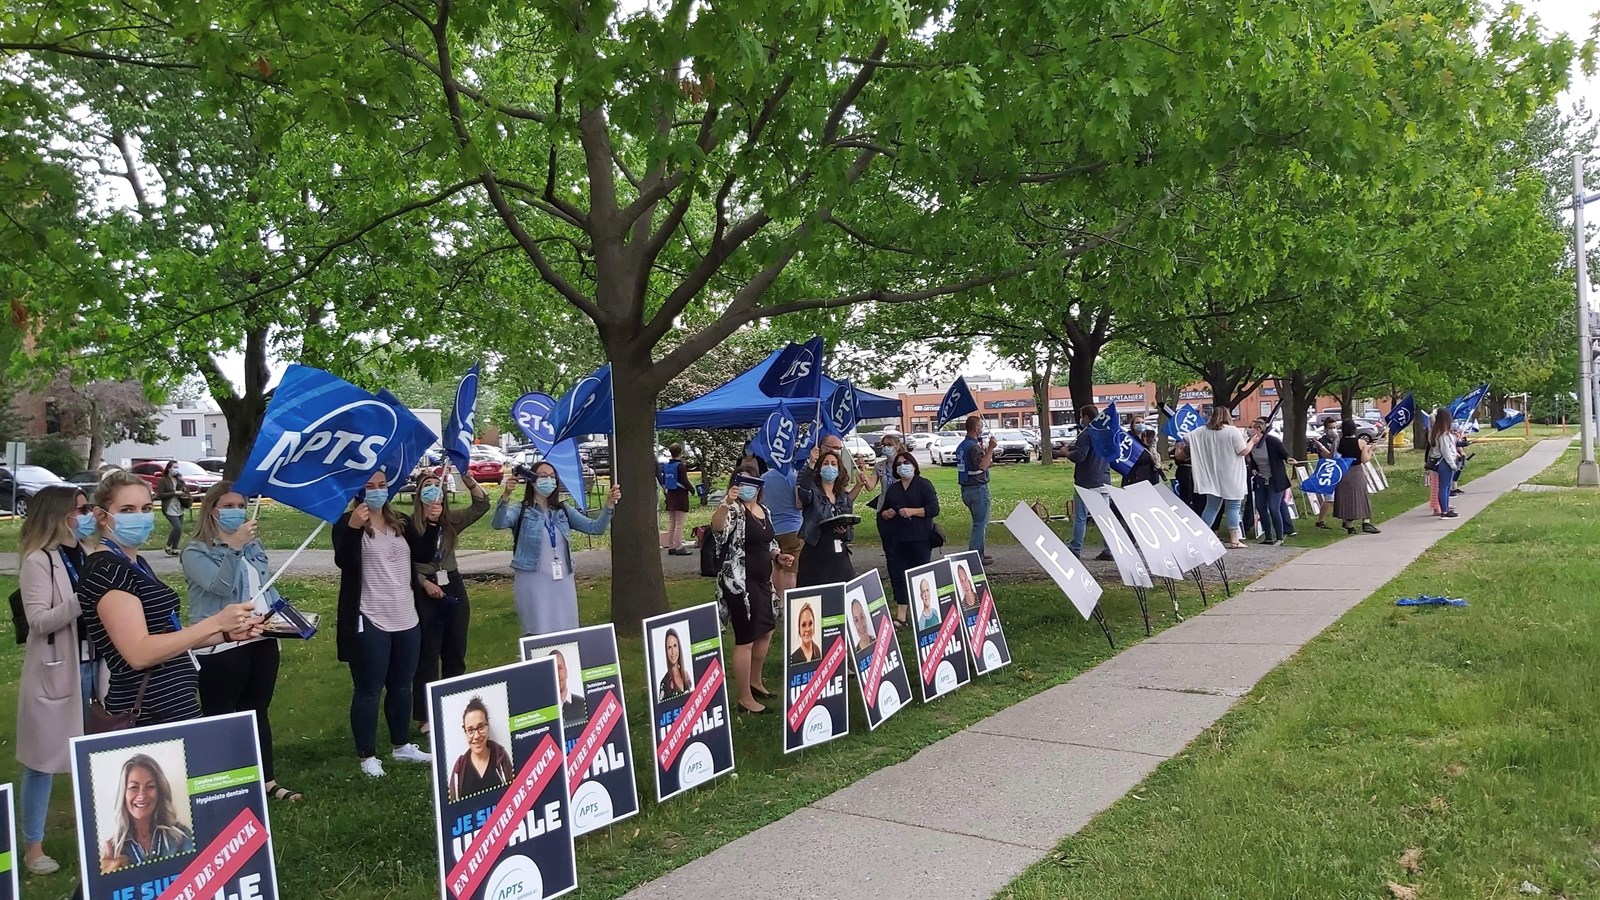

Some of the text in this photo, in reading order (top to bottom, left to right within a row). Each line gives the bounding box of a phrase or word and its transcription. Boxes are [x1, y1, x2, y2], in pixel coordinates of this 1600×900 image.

[770, 416, 794, 469] APTS
[1177, 411, 1197, 440] APTS
[255, 430, 388, 471] APTS
[1319, 458, 1337, 486] APTS
[1098, 514, 1133, 556] X
[1130, 512, 1160, 550] O
[1149, 506, 1182, 543] D
[1170, 504, 1203, 538] E
[1035, 534, 1075, 580] E
[791, 674, 801, 686] JE
[586, 730, 598, 749] DE
[595, 699, 617, 735] STOCK
[660, 748, 670, 764] EN
[668, 704, 696, 748] RUPTURE
[694, 692, 704, 708] DE
[702, 666, 720, 697] STOCK
[660, 710, 672, 726] JE
[810, 722, 823, 732] APTS
[687, 760, 703, 774] APTS
[196, 788, 250, 805] Hygiéniste dentaire
[579, 802, 599, 817] APTS
[452, 813, 473, 836] JE
[453, 870, 470, 897] EN
[468, 804, 515, 875] RUPTURE
[512, 785, 528, 810] DE
[526, 744, 556, 791] STOCK
[193, 863, 216, 891] DE
[213, 819, 258, 871] STOCK
[498, 881, 524, 900] APTS
